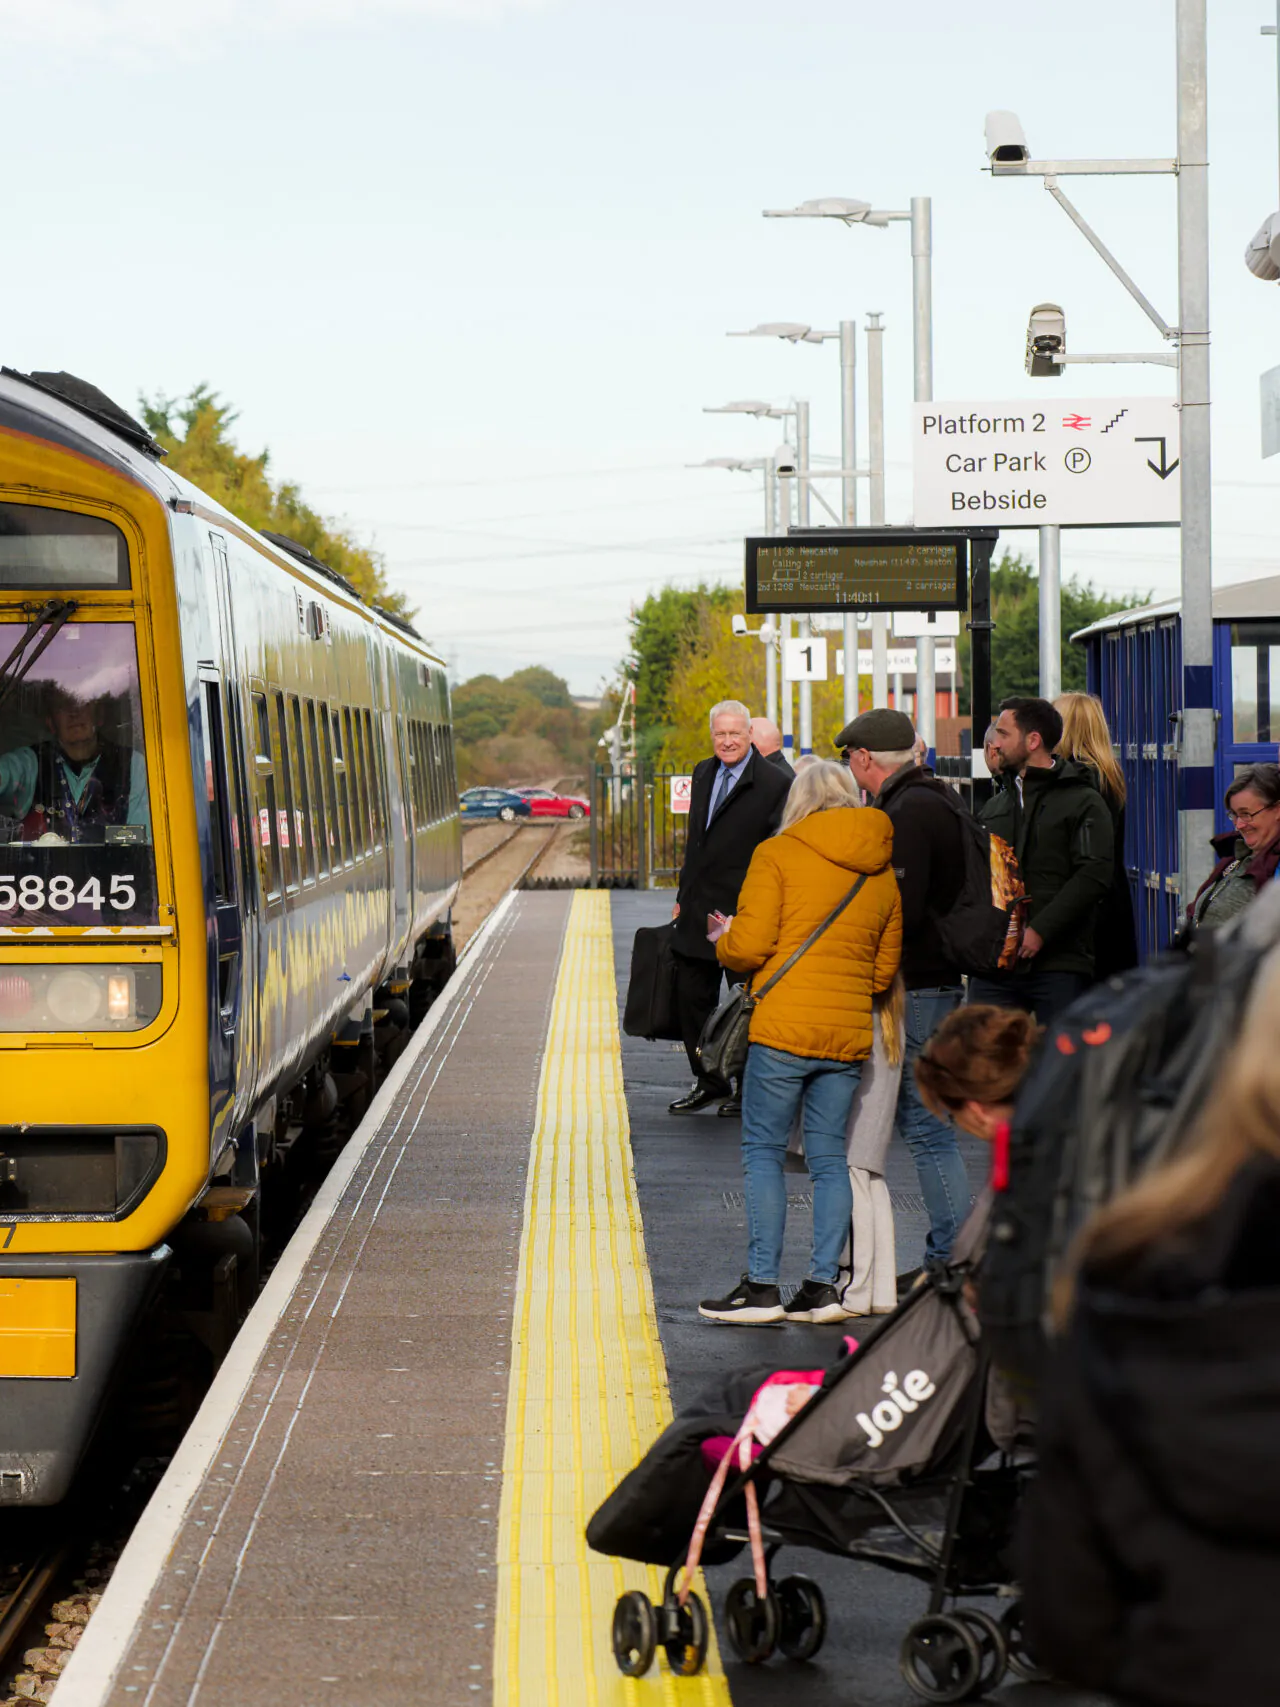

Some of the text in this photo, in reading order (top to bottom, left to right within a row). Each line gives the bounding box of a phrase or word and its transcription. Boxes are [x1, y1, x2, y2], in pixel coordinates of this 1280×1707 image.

[922, 413, 1046, 435] Platform 2
[945, 451, 1047, 473] Car Park
[951, 490, 1047, 510] Bebside
[772, 559, 802, 570] Calling
[835, 591, 880, 604] 11:40:11
[800, 646, 812, 672] 1
